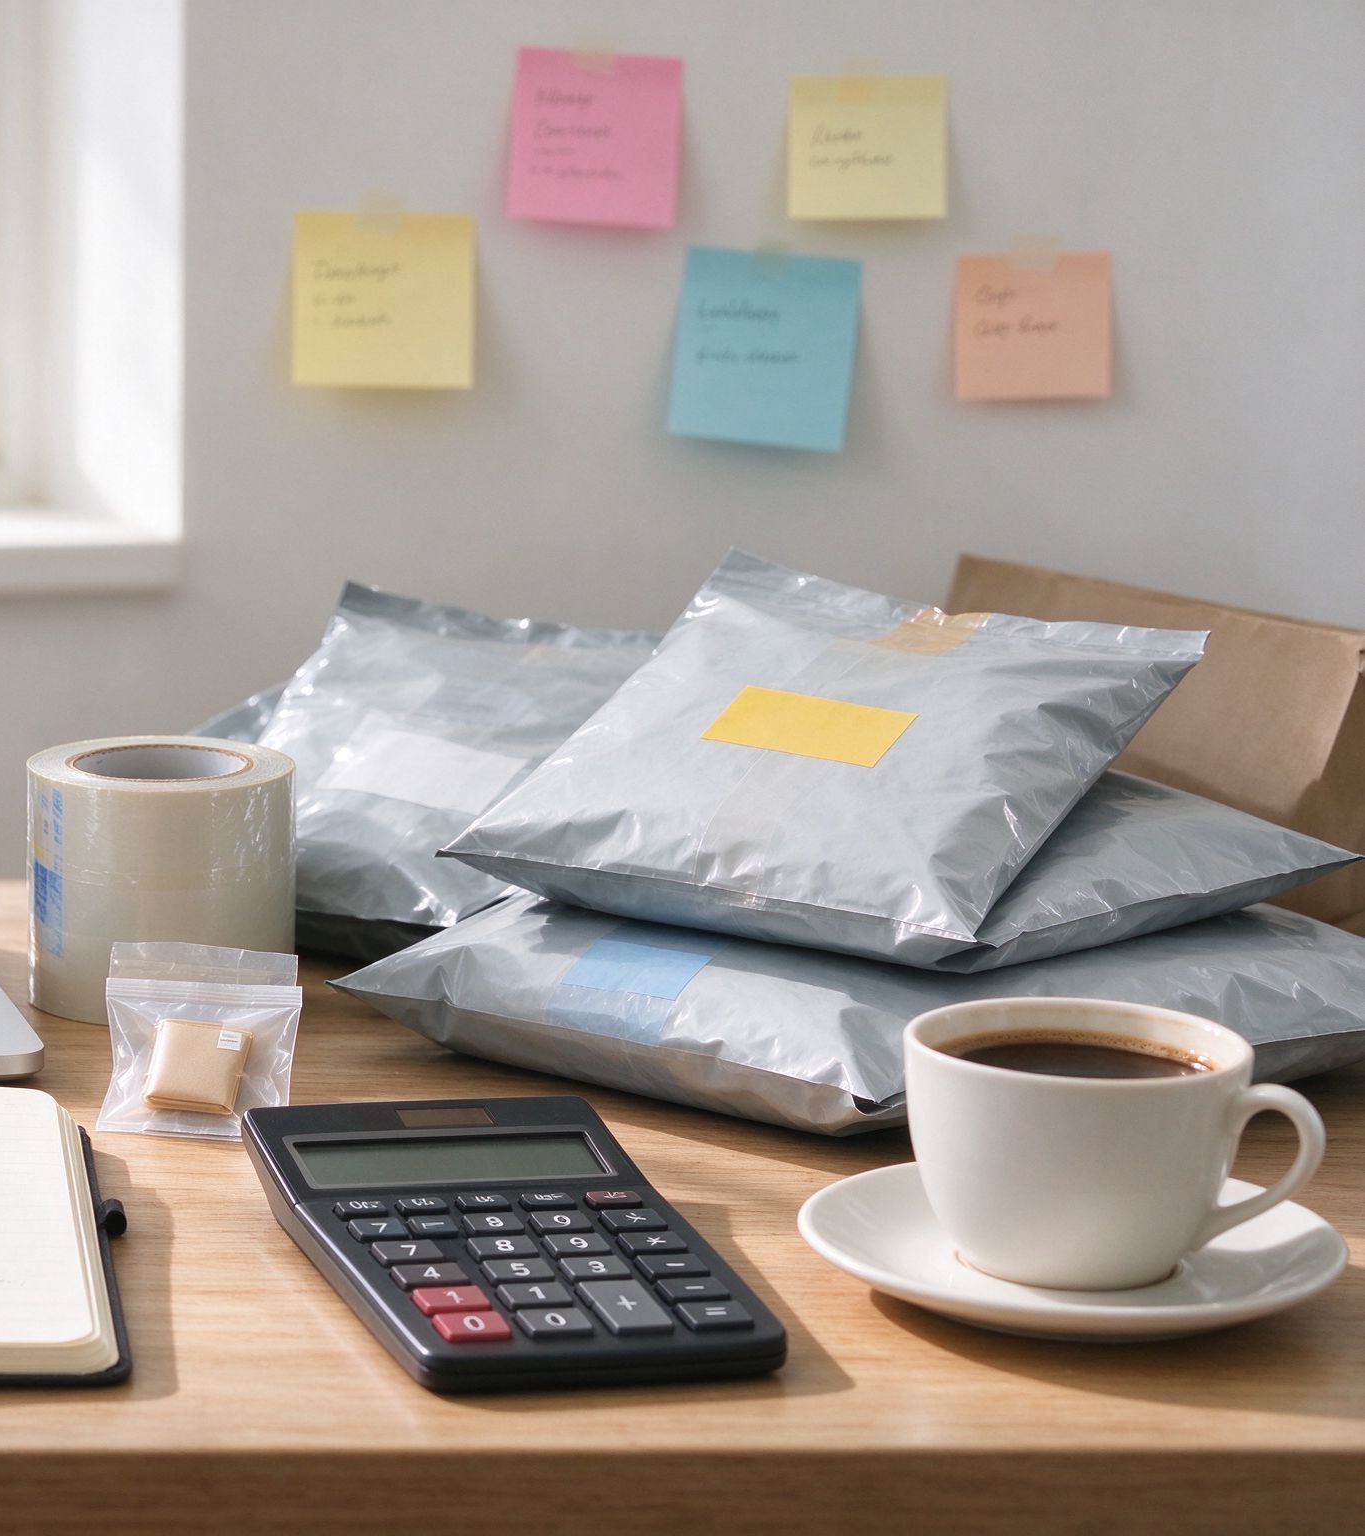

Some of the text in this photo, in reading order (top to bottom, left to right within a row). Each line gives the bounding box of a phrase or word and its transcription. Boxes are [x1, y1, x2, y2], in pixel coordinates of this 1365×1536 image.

[400, 1244, 417, 1257] 7
[495, 1239, 515, 1252] 8
[423, 1266, 441, 1280] 4
[510, 1262, 531, 1276] 5
[528, 1286, 546, 1300] 1
[462, 1315, 486, 1331] 0
[544, 1312, 567, 1326] 0
